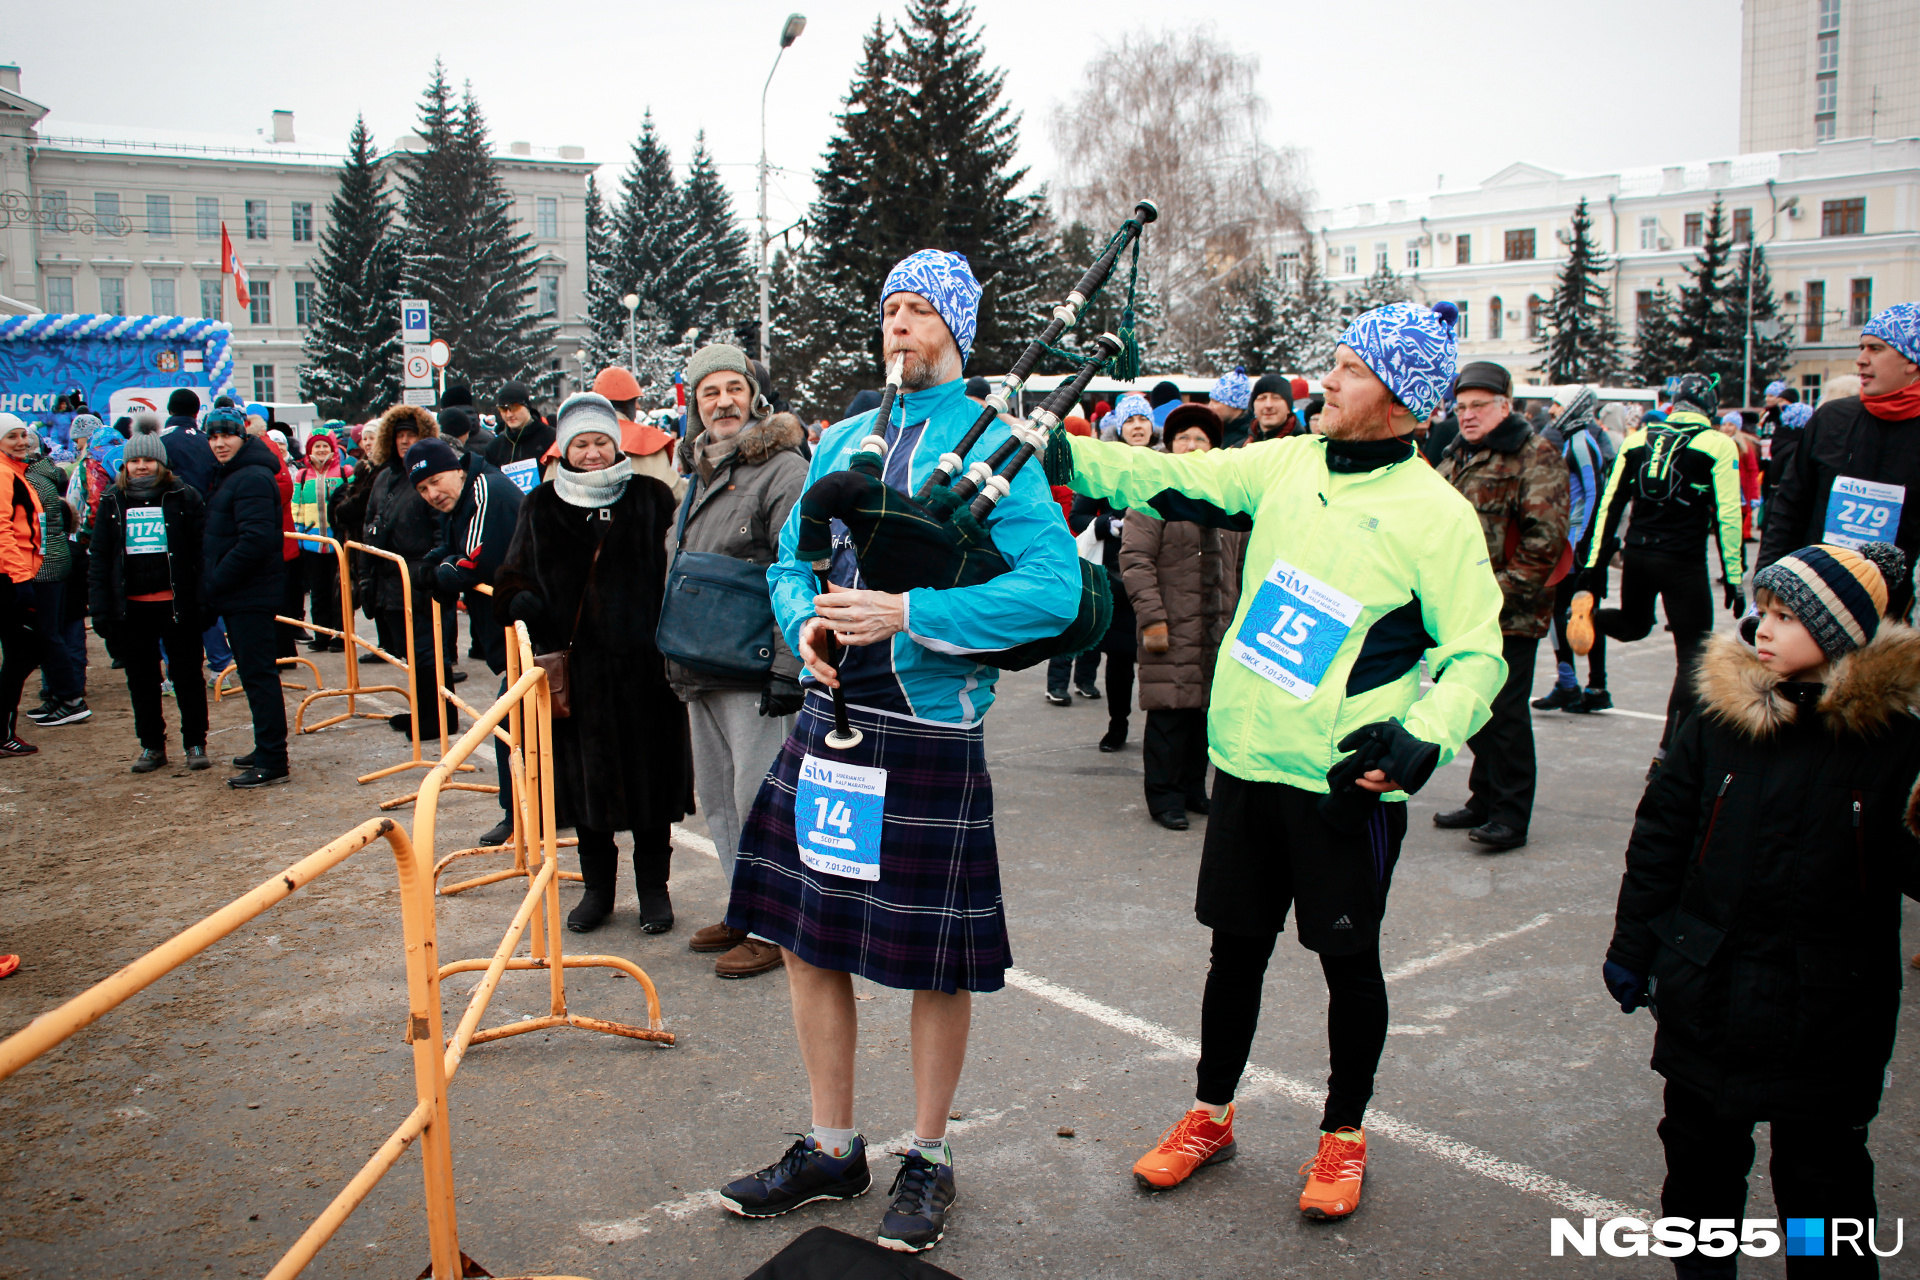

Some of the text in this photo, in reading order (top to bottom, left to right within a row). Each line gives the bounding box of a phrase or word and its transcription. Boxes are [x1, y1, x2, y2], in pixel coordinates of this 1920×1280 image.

[415, 362, 422, 373] 5
[1837, 500, 1890, 528] 279
[127, 521, 165, 537] 1174
[1308, 595, 1346, 618] HALF MARATHON
[1311, 589, 1340, 608] SIBERIAN ICE
[1270, 605, 1317, 645] 15
[1266, 640, 1290, 656] ADRIAN
[1240, 652, 1296, 688] ОМСК 7.01.2019
[847, 782, 876, 790] MARATHON
[814, 796, 852, 835] 14
[820, 835, 841, 845] SCOTT
[825, 861, 861, 875] 7.01.2019
